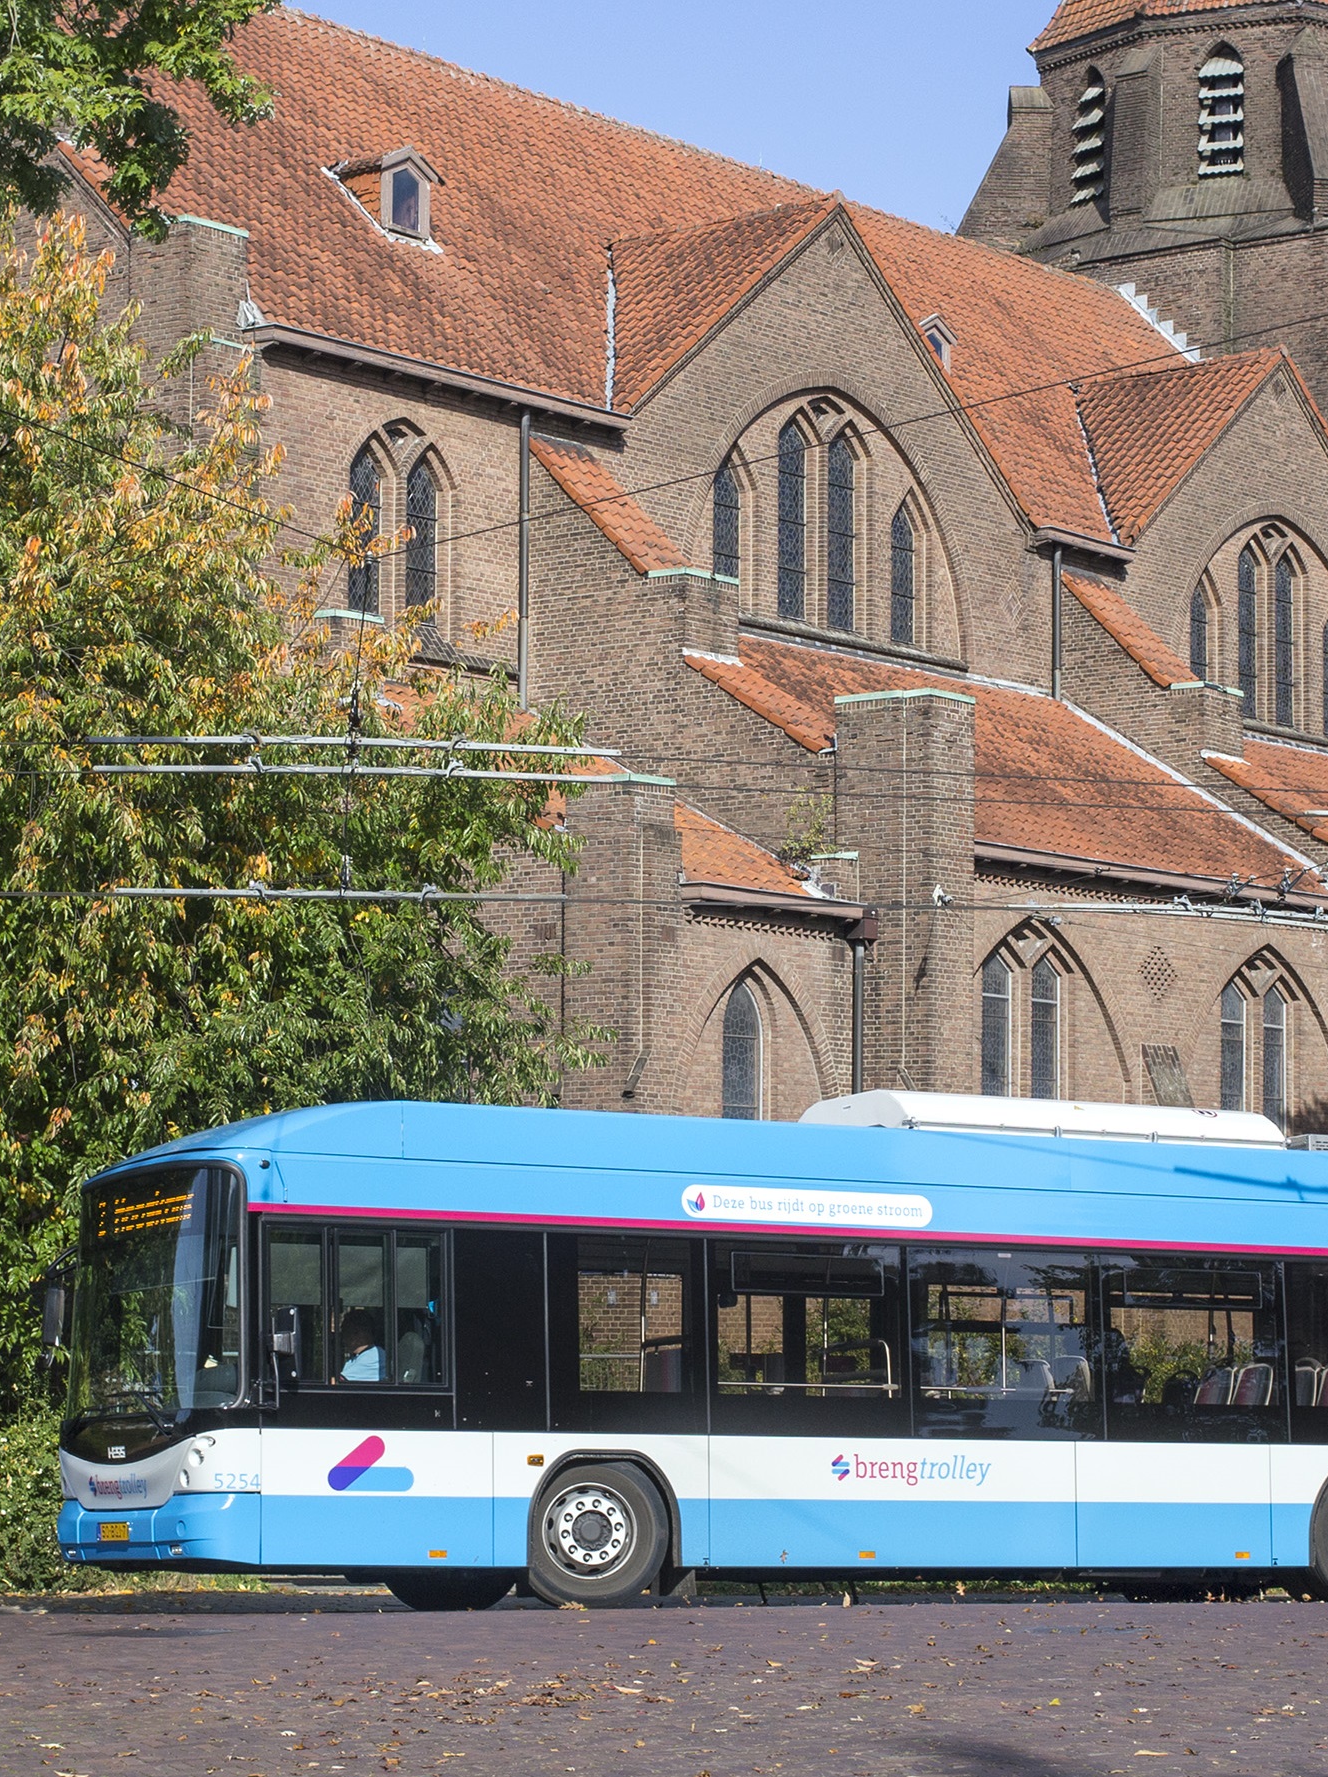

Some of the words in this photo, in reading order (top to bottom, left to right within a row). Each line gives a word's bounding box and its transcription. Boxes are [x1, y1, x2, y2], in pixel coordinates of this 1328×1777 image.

[713, 1195, 745, 1209] Deze
[750, 1196, 773, 1210] bus
[777, 1199, 804, 1214] rijdt
[809, 1202, 825, 1216] op
[829, 1203, 873, 1217] groene
[877, 1204, 923, 1217] stroom
[214, 1473, 261, 1490] 5254
[853, 1453, 991, 1486] brengtrolley
[96, 1472, 147, 1499] brengtrolley
